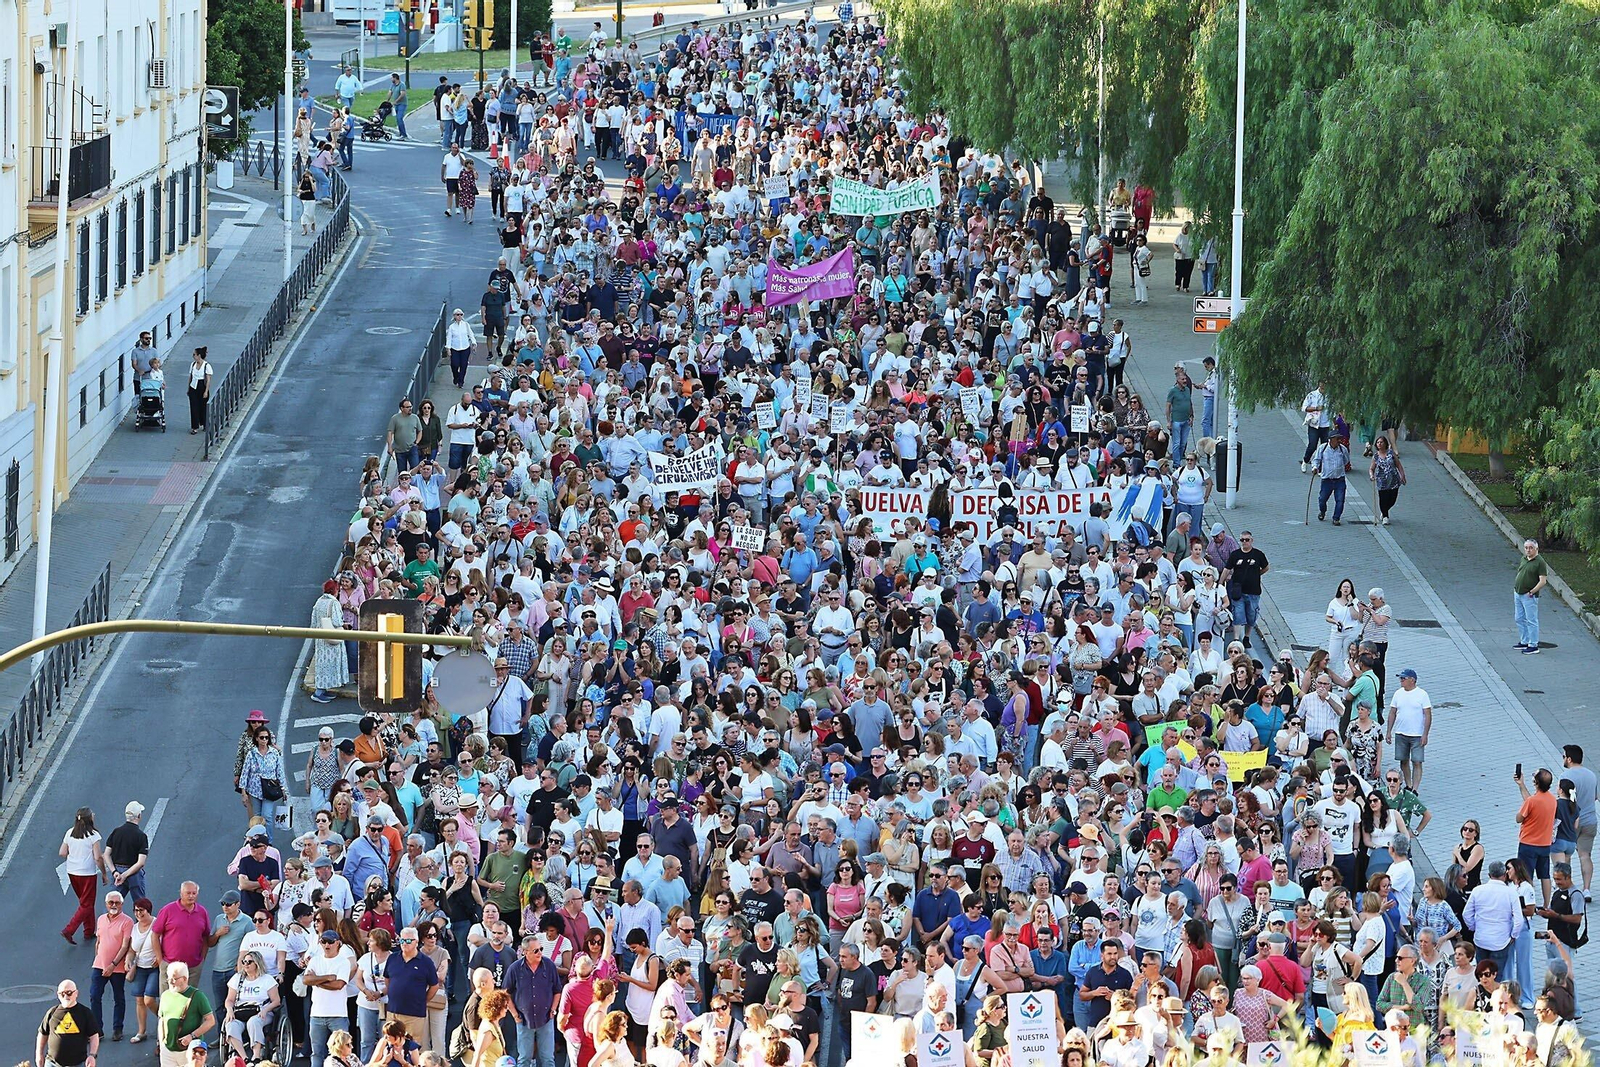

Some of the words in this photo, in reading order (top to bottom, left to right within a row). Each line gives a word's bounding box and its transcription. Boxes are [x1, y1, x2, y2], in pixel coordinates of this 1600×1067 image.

[772, 274, 787, 282] Más
[771, 284, 786, 292] Más
[962, 494, 1050, 515] DEFSA
[1057, 494, 1082, 513] DE
[736, 541, 759, 550] NEGOCIA
[1017, 1033, 1049, 1041] NUESTRA
[1022, 1045, 1045, 1053] SALUD
